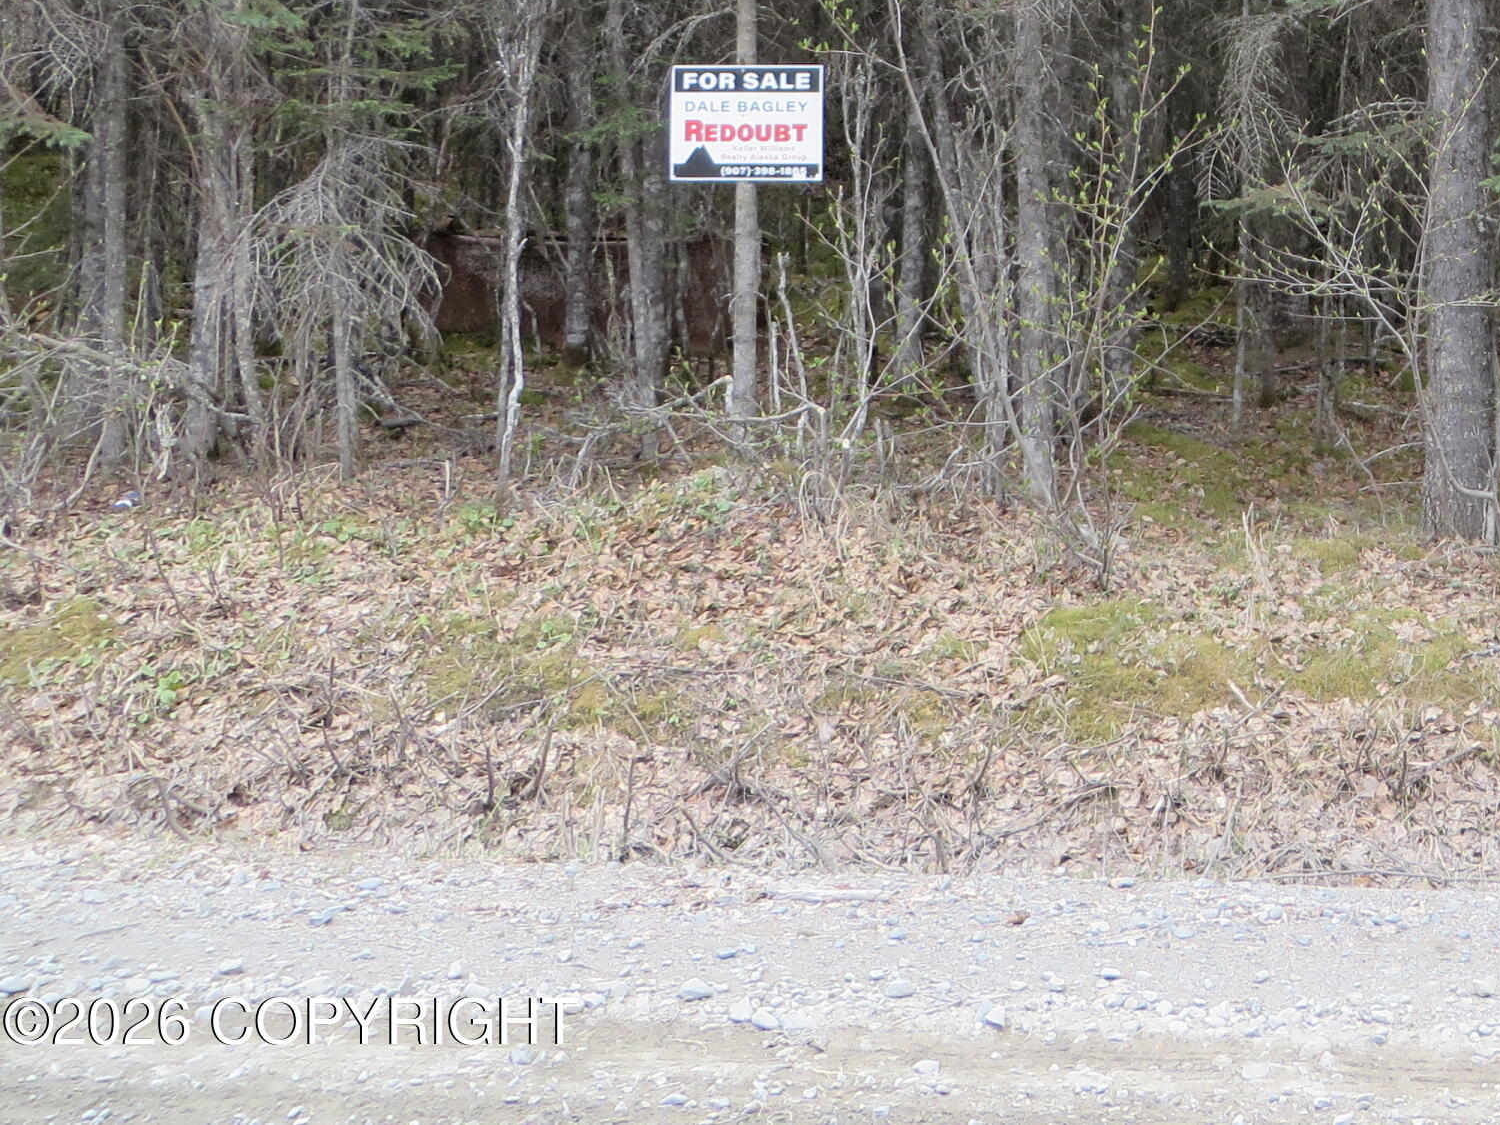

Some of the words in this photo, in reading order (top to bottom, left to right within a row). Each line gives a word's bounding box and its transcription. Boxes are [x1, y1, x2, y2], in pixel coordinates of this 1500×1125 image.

[683, 72, 735, 90] FOR
[742, 72, 811, 90] SALE
[685, 101, 730, 112] DALE
[737, 101, 808, 112] BAGLEY
[720, 153, 747, 161] Realty
[781, 153, 808, 161] Group
